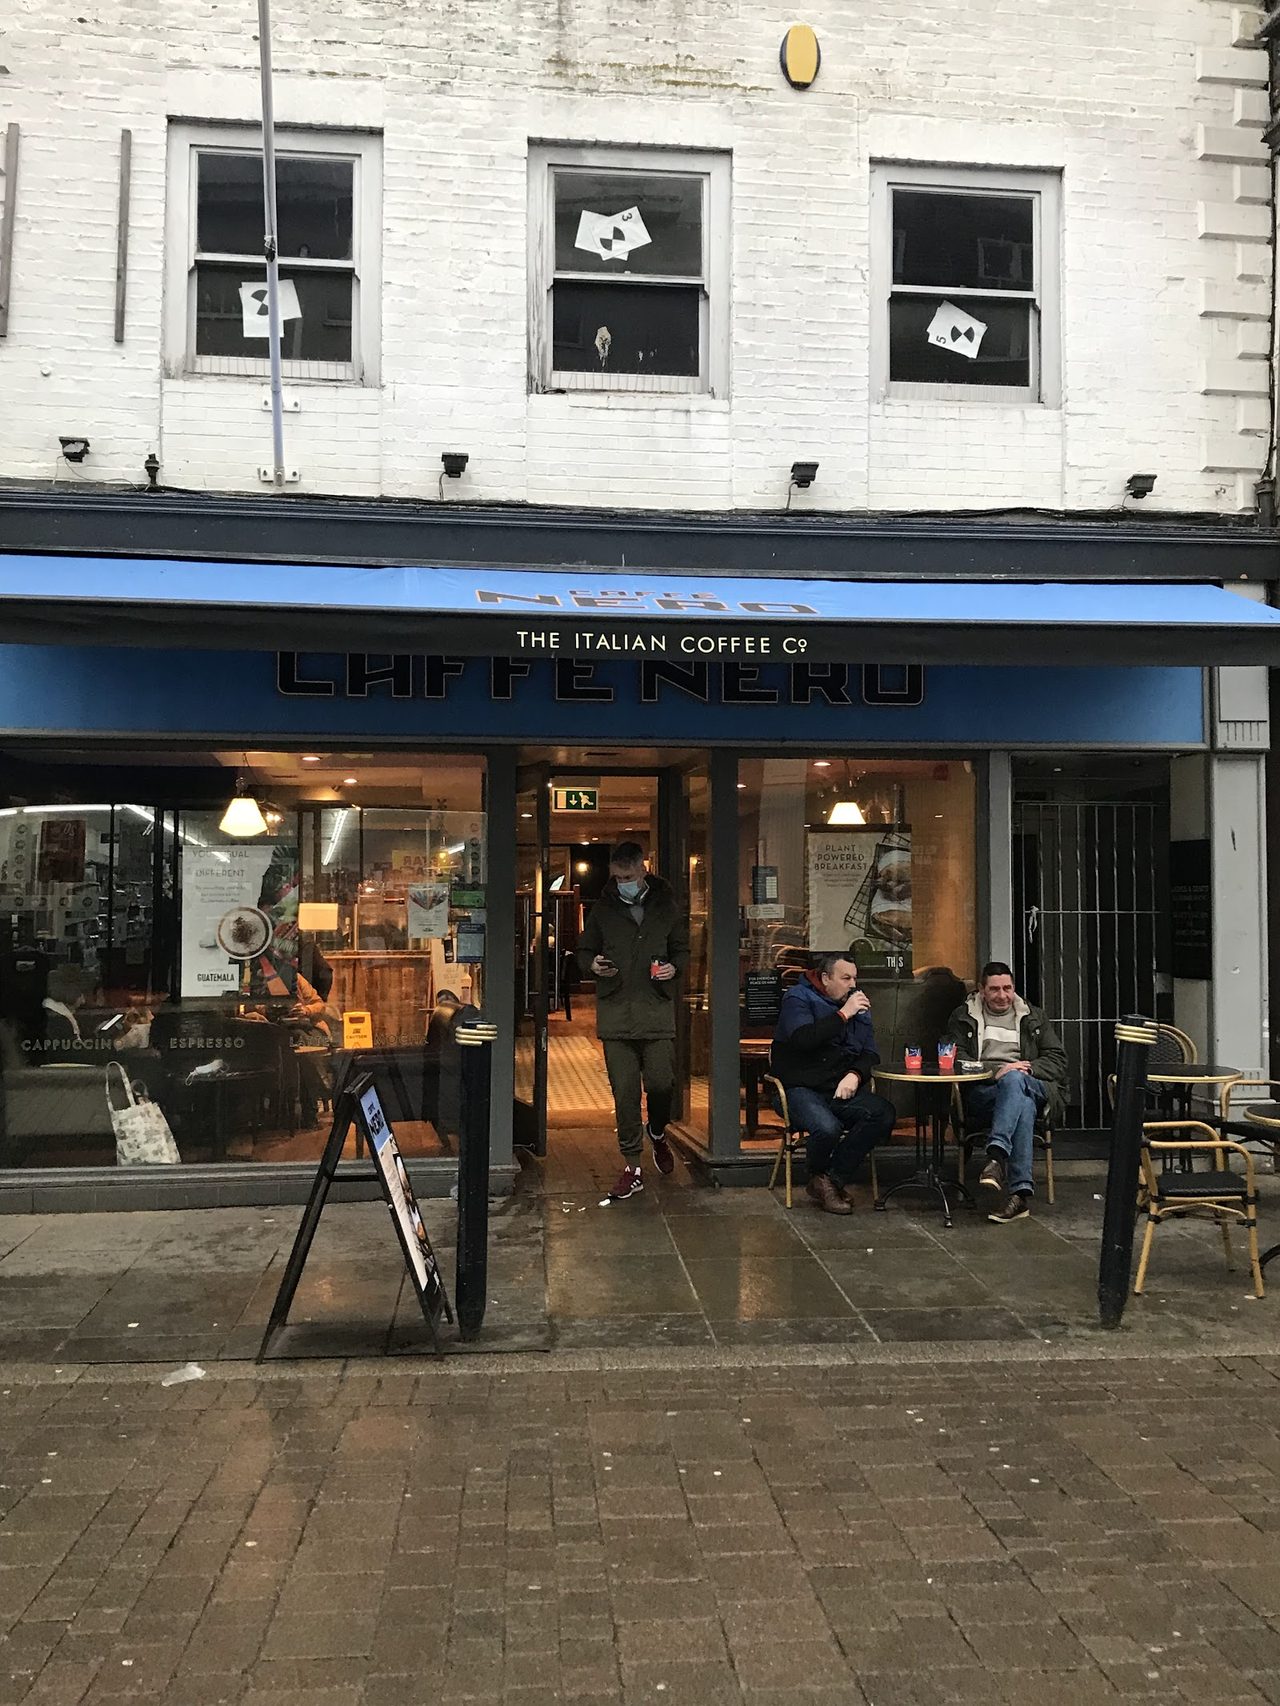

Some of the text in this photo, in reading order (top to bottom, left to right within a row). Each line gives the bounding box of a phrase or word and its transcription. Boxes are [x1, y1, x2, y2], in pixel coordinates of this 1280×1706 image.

[621, 212, 633, 222] 3
[935, 335, 947, 345] 5
[476, 589, 821, 615] NERO
[516, 631, 560, 648] THE
[575, 633, 666, 651] ITALIAN
[680, 636, 771, 653] COFFEE
[641, 660, 925, 706] NERO
[825, 844, 856, 852] PLANT
[817, 854, 865, 862] POWERED
[814, 863, 867, 871] BREAKFAST
[195, 869, 245, 877] DIFFERENT
[197, 973, 235, 982] GUATEMALA
[169, 1036, 246, 1049] ESPRESSO
